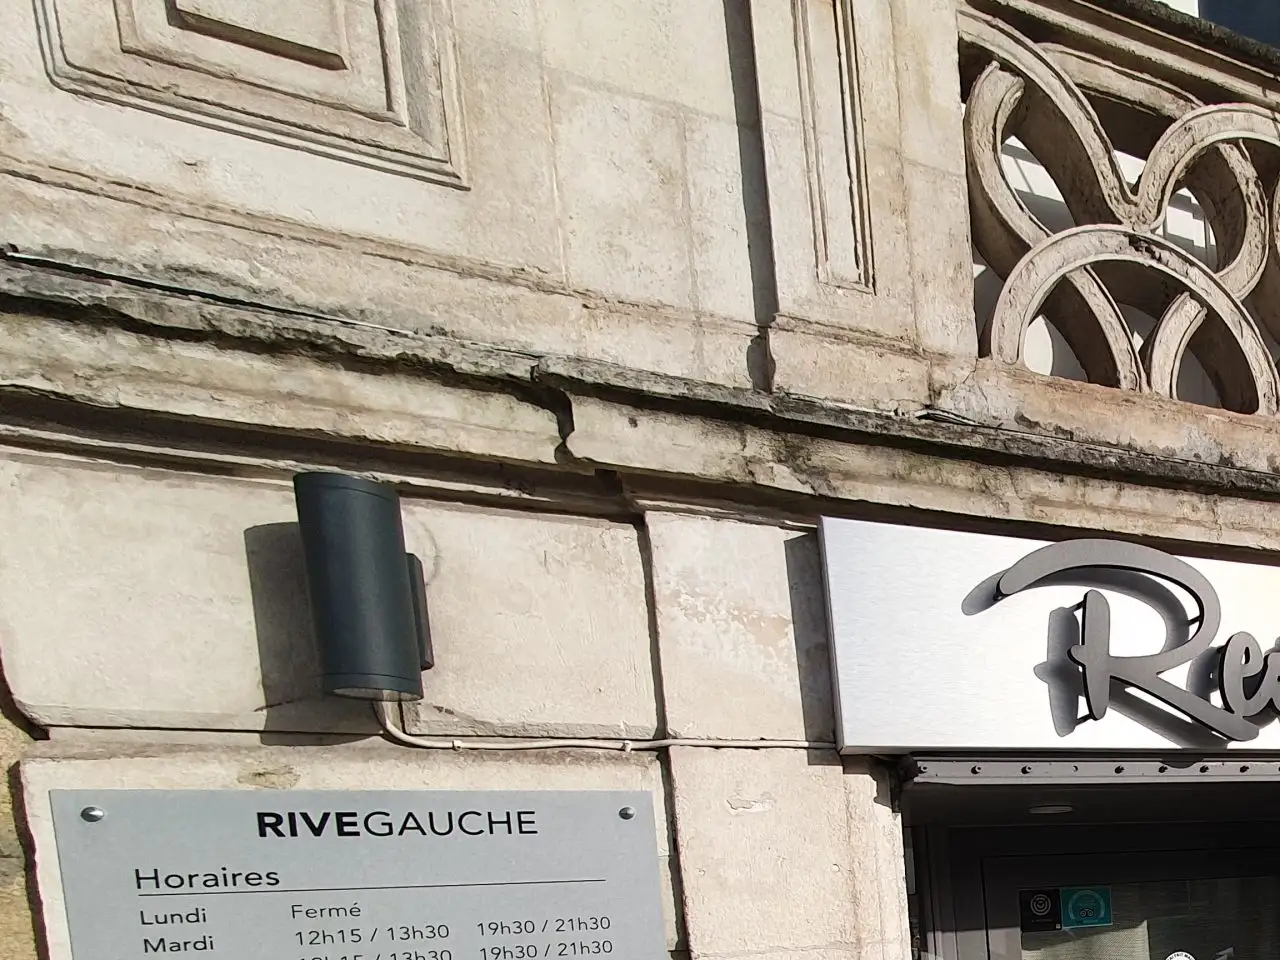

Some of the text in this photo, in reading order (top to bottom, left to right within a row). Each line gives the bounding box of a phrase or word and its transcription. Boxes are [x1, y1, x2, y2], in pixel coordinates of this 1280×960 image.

[256, 810, 538, 838] RIVEGAUCHE
[134, 866, 280, 890] Horaires
[140, 902, 361, 926] Lundi Fermé
[143, 916, 611, 954] Mardi 12h15 / 13h30 19h30 / 21h30
[479, 944, 538, 960] 19h30
[544, 943, 551, 958] /
[557, 940, 613, 957] 21h30
